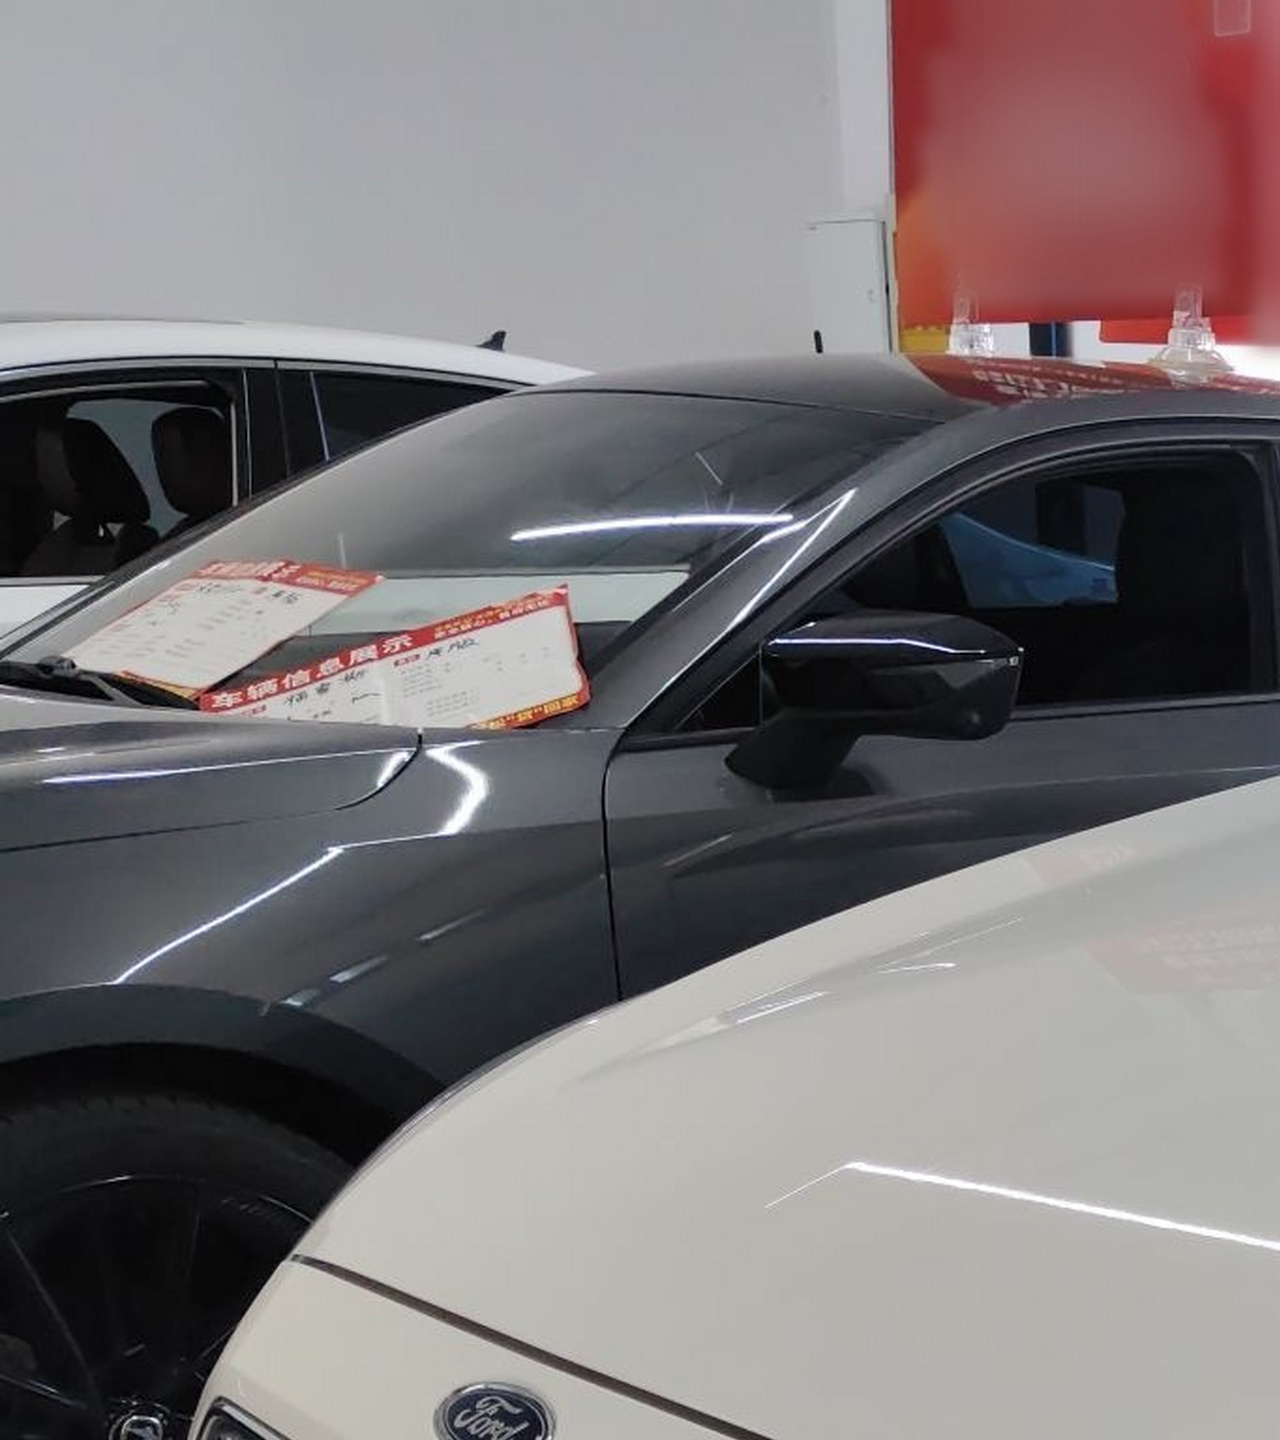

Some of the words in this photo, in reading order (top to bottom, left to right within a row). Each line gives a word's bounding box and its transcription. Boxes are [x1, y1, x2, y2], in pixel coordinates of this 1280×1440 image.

[211, 634, 413, 708] 车辆信息展示
